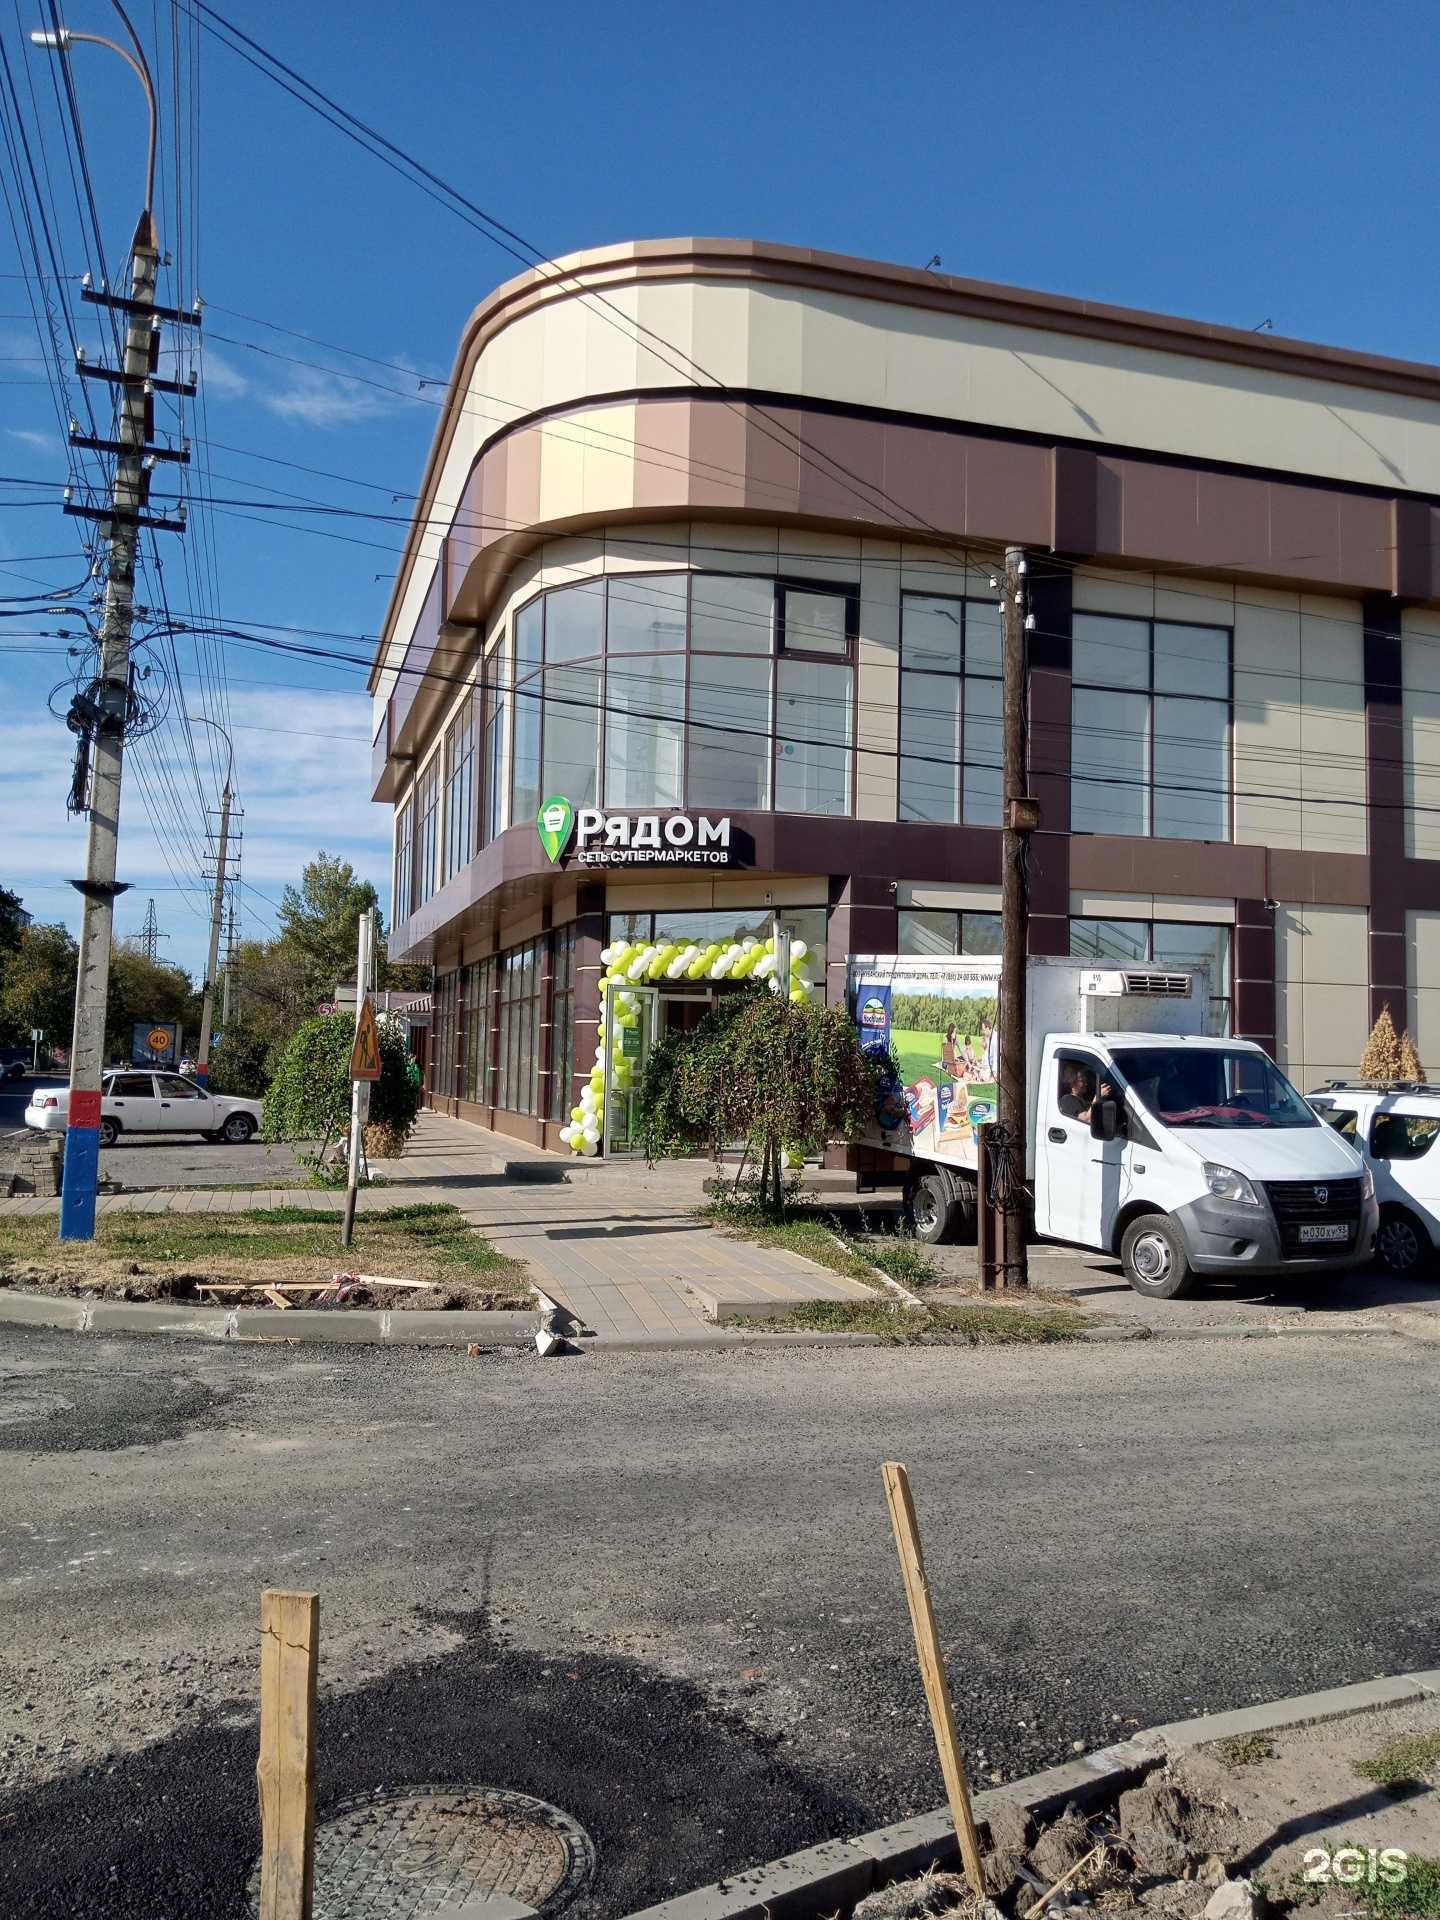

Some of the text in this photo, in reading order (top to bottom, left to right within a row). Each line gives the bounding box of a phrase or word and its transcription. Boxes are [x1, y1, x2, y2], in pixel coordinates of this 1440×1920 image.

[577, 850, 729, 863] СЕТЬ СУПЕРМАРКЕТОВ
[152, 1036, 166, 1044] 40
